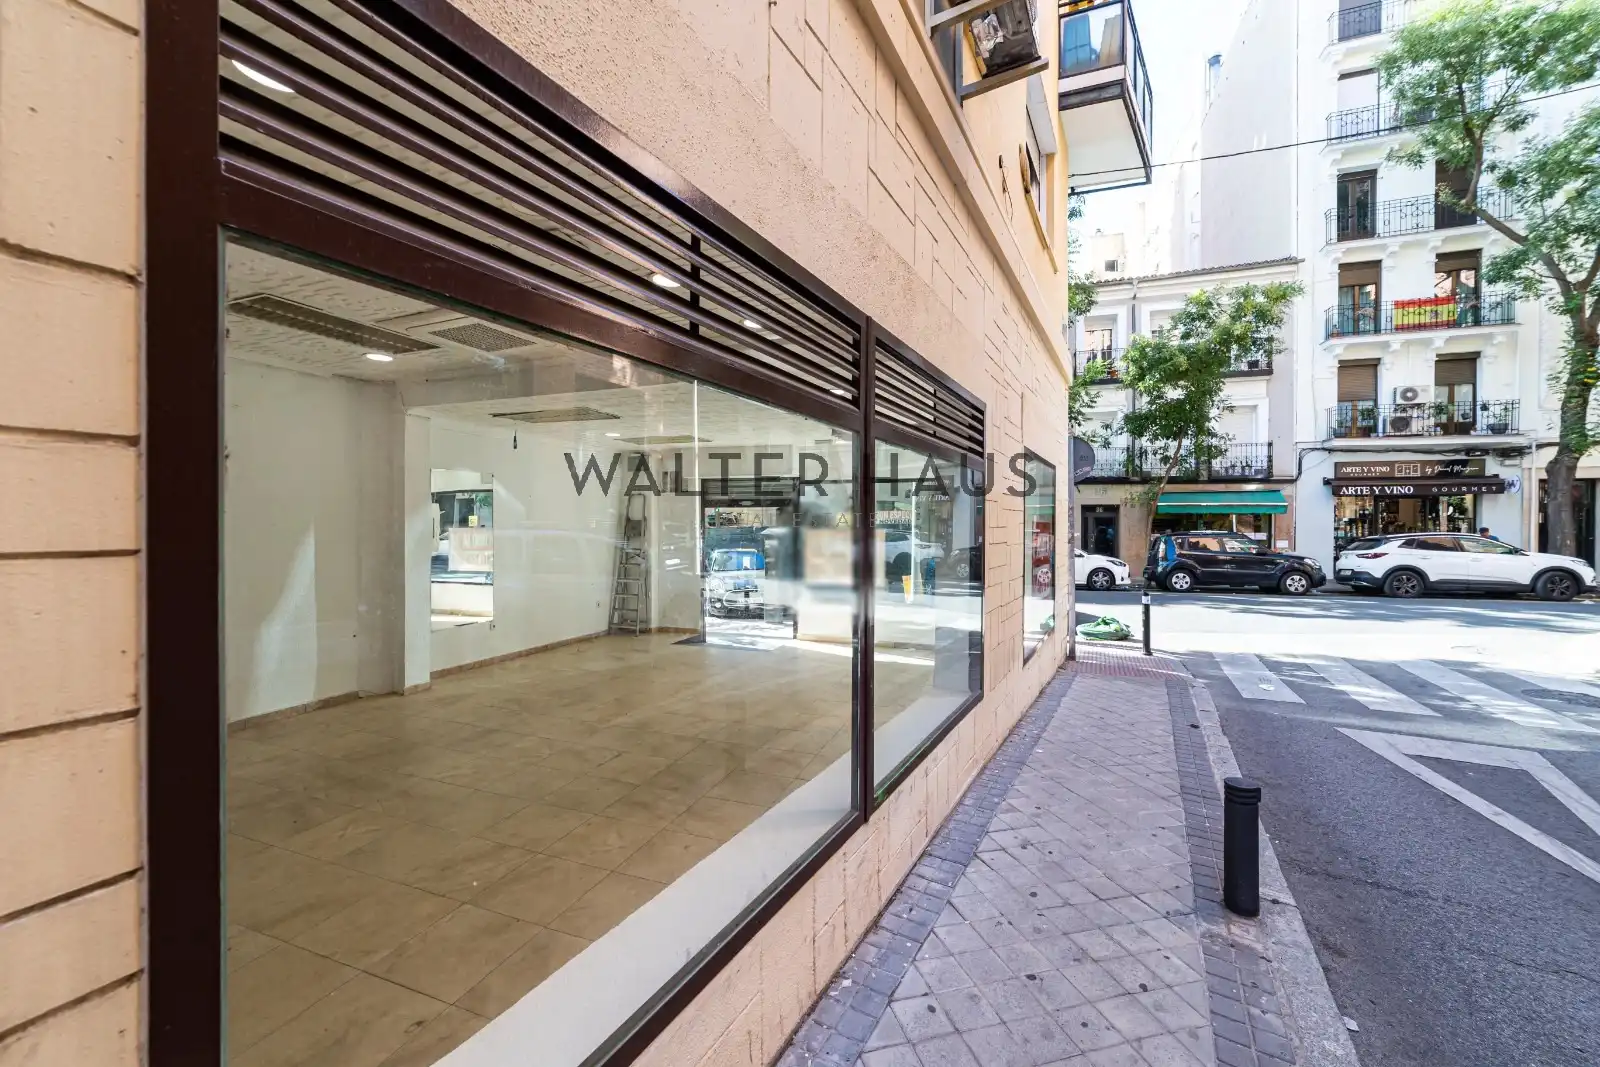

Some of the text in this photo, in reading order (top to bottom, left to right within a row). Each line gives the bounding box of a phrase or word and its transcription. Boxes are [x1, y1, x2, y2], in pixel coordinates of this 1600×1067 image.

[1339, 485, 1414, 495] ARTE Y VINO
